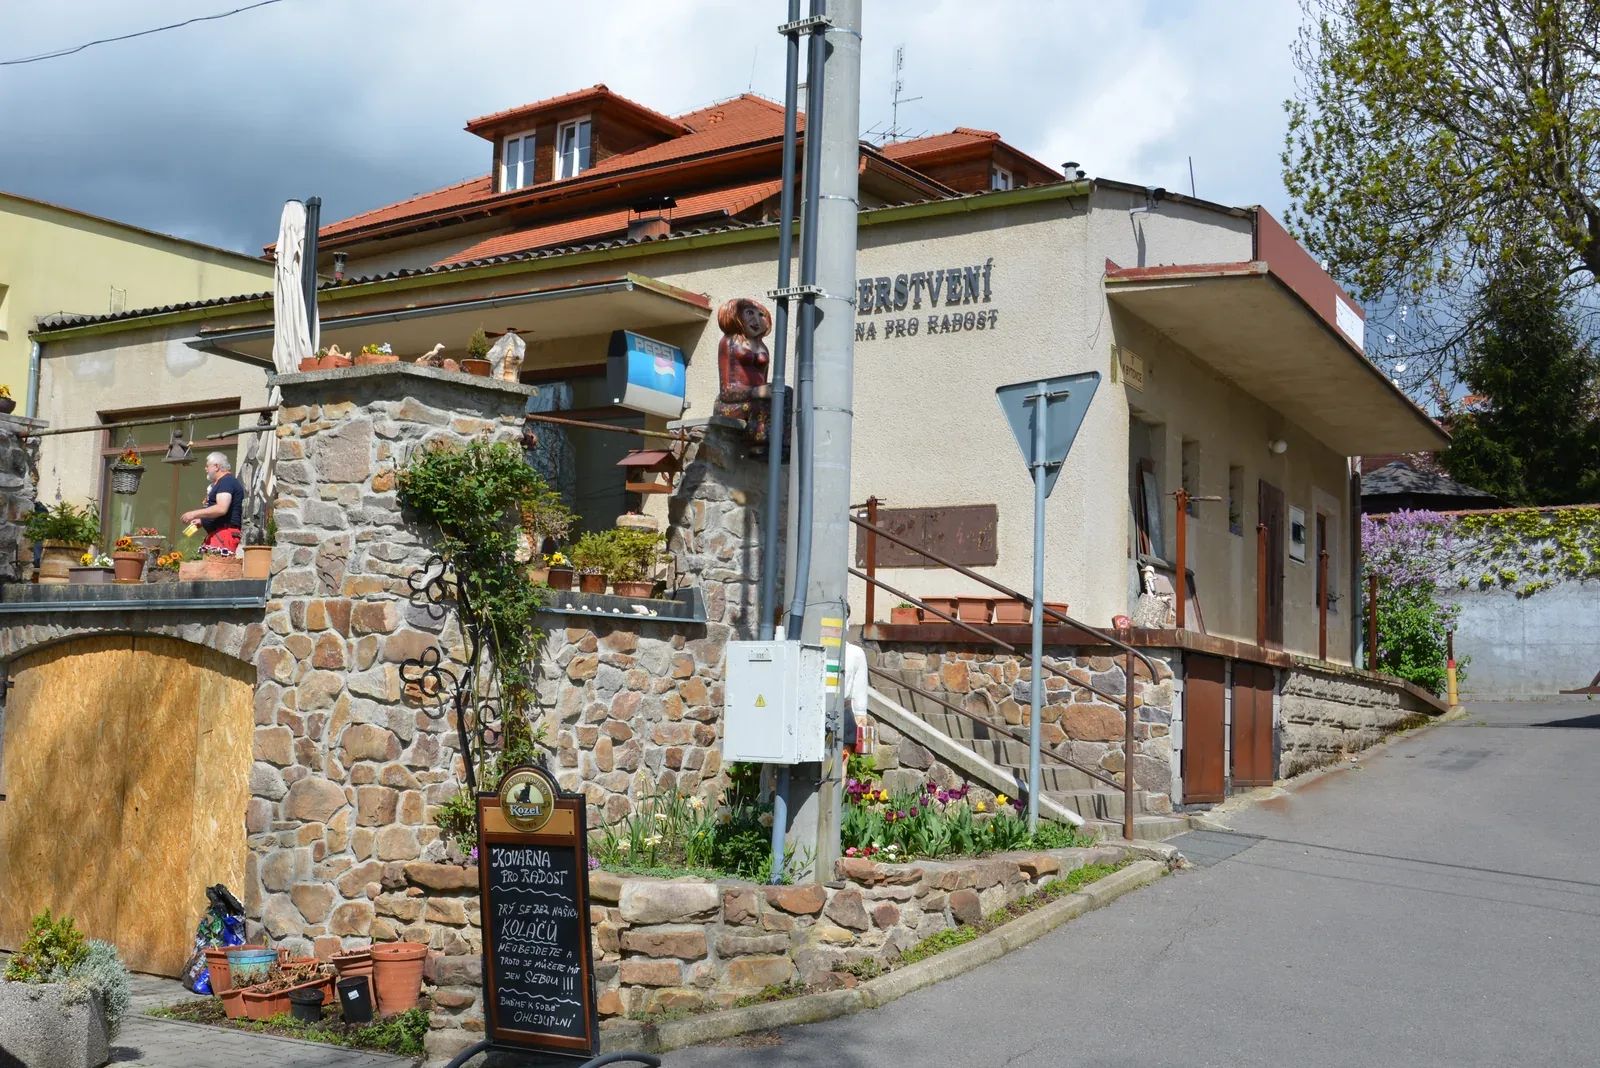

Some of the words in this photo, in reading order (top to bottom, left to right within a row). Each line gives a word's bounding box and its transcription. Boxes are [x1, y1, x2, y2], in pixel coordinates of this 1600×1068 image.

[856, 257, 994, 314] ERSTVENÍ
[855, 321, 877, 341] NA
[885, 317, 919, 338] PRO
[927, 309, 998, 335] RADOST
[634, 336, 675, 361] PEPSI
[509, 804, 544, 817] Kozel
[500, 869, 519, 884] PRO
[520, 868, 568, 885] RADOST
[498, 901, 517, 917] PRÝ
[518, 904, 533, 915] SE
[501, 918, 558, 942] KOLÁČŮ
[498, 942, 563, 957] NEOBEJDETE
[566, 950, 573, 959] A
[523, 959, 533, 967] JE
[534, 959, 566, 972] MŮŽETE
[504, 972, 521, 980] JEN
[524, 970, 559, 986] SEBOU
[528, 1001, 534, 1009] K
[513, 1011, 577, 1028] OHLEDUPLNÍ
